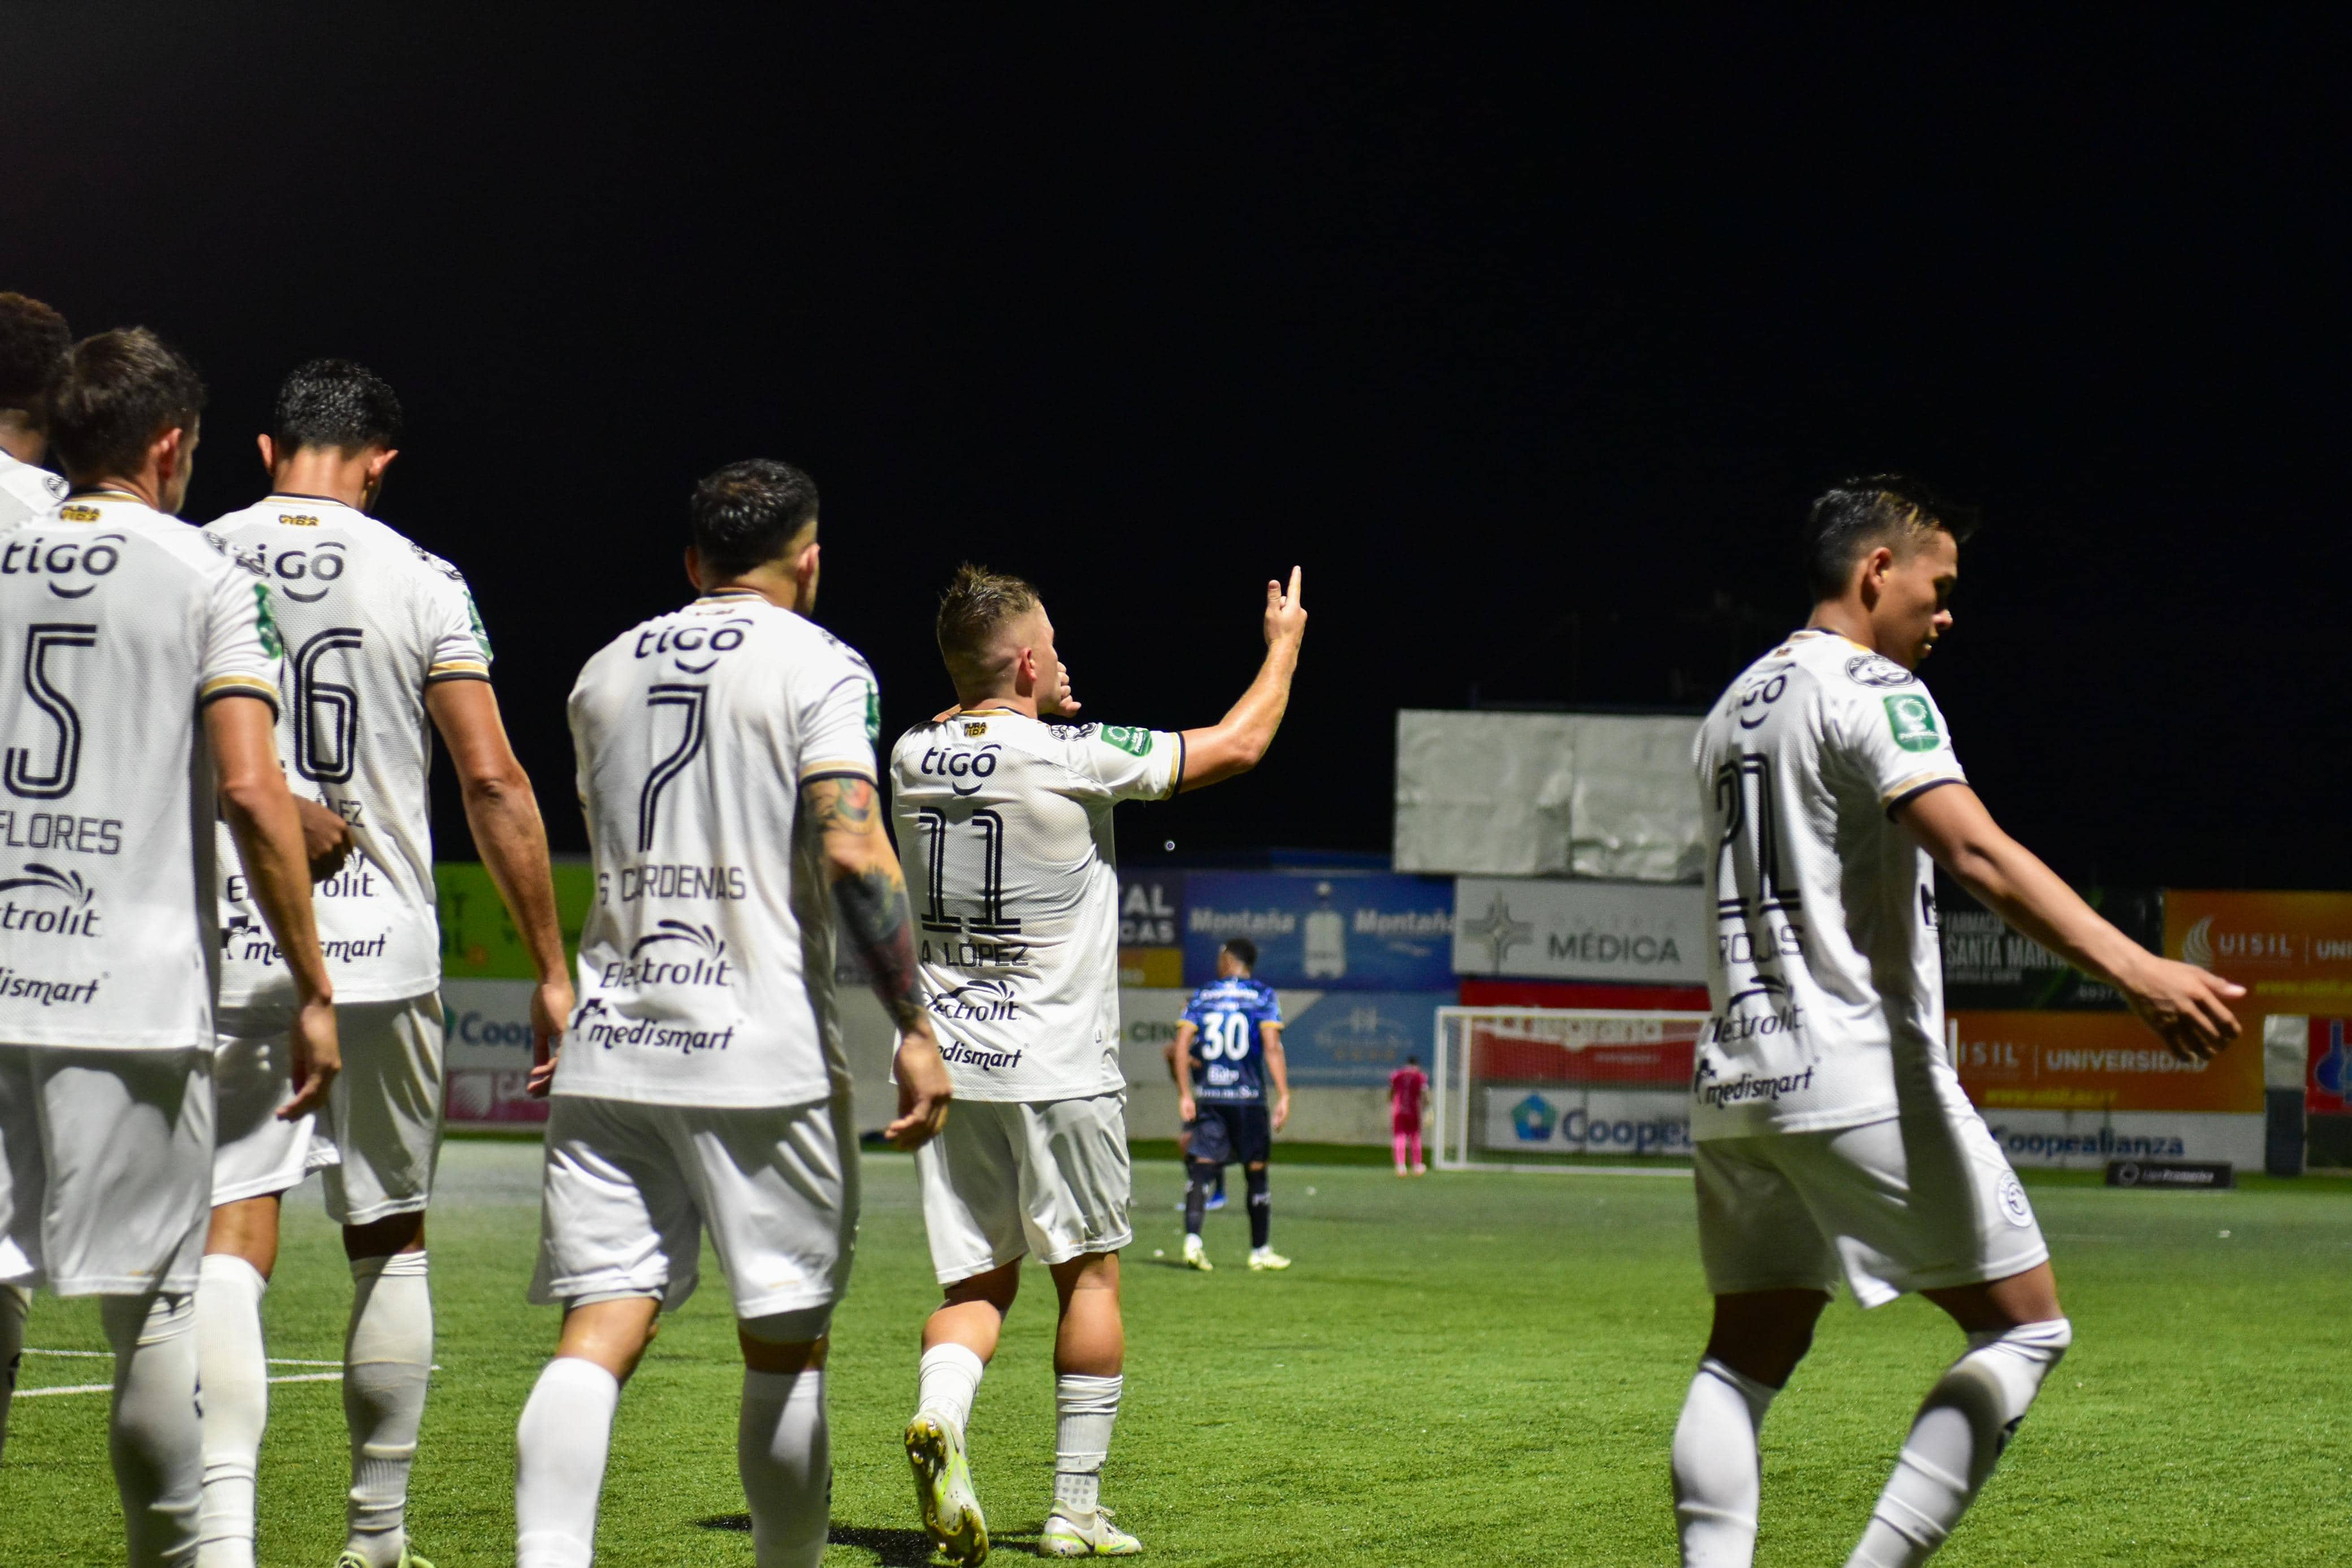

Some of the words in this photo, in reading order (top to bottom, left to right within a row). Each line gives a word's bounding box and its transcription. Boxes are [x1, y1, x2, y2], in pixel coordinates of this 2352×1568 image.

[5, 623, 97, 800] 5
[295, 627, 363, 785] 6
[638, 683, 710, 852] 7
[1717, 753, 1801, 919] 21
[621, 865, 746, 903] CRDENAS
[919, 806, 1021, 934] 11
[922, 939, 932, 965] A
[1548, 926, 1681, 964] MÉDICA
[2219, 933, 2293, 956] UISIL
[588, 1017, 734, 1054] medismart
[1202, 1011, 1249, 1060] 30
[1706, 1066, 1814, 1109] medismart
